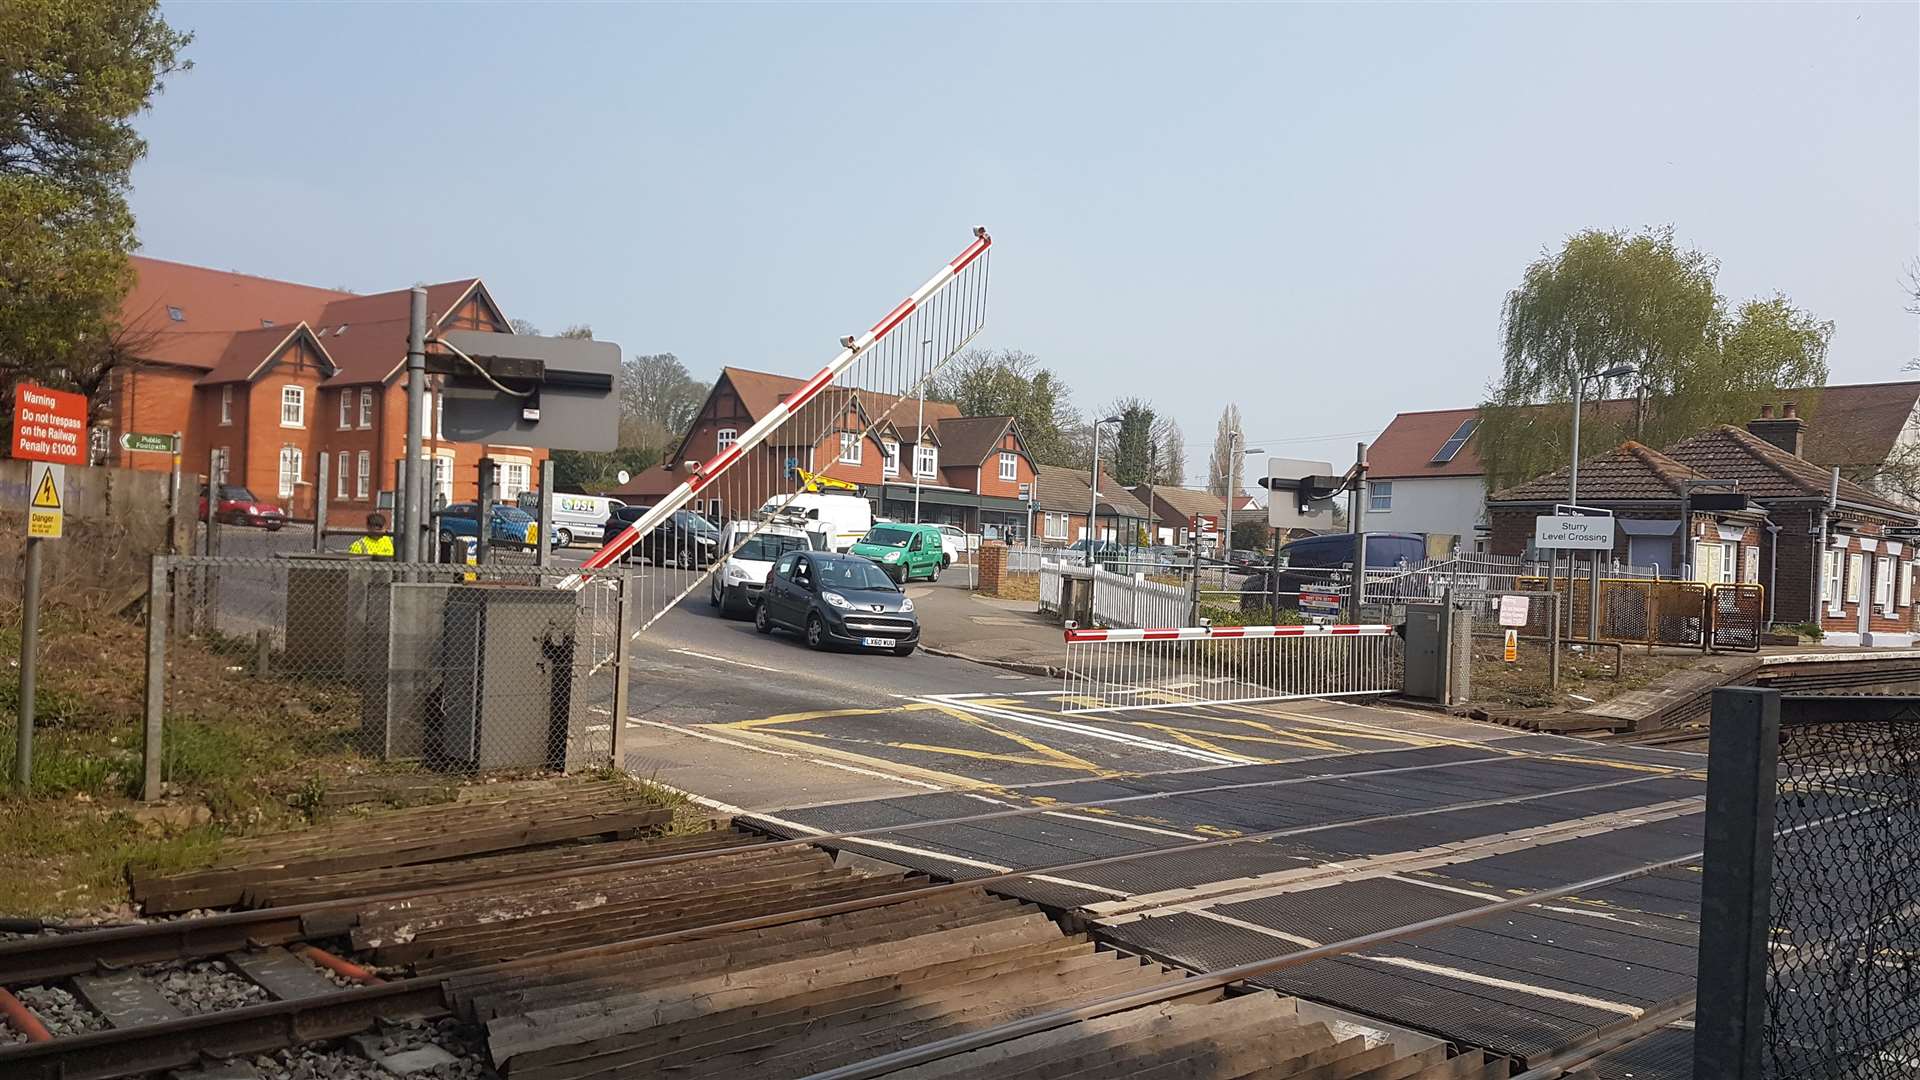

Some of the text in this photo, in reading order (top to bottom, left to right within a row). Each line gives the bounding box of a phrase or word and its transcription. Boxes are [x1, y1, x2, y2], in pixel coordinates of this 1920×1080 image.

[23, 390, 56, 409] Warning
[22, 408, 81, 429] Do not trespass
[21, 425, 77, 444] on the Railway
[141, 435, 161, 444] Public
[20, 438, 77, 457] Penalty £1000
[135, 441, 167, 450] Footpath
[574, 500, 593, 511] DSL
[32, 513, 54, 524] Danger
[1561, 522, 1588, 532] Sturry
[1542, 532, 1608, 543] Level Crossing
